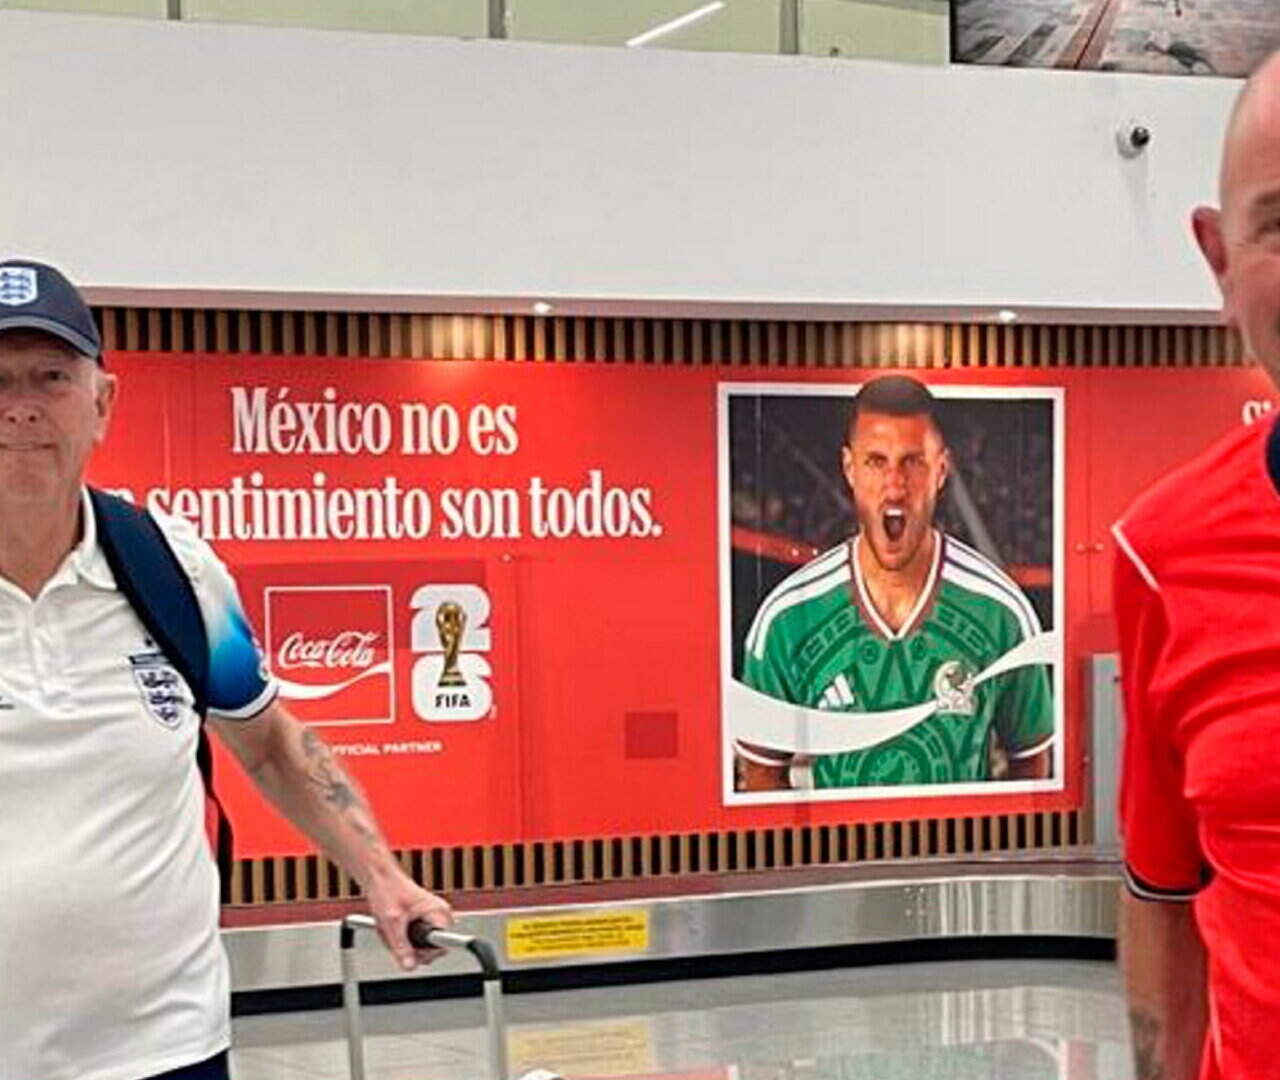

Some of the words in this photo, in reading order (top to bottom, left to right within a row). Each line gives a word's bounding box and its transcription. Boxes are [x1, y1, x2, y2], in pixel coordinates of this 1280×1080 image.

[230, 386, 391, 455] México
[401, 403, 460, 455] no
[467, 403, 519, 455] es
[146, 471, 432, 540] sentimiento
[440, 487, 522, 539] son
[528, 469, 663, 539] todos.
[435, 695, 471, 708] FIFA
[383, 741, 443, 755] PARTNER
